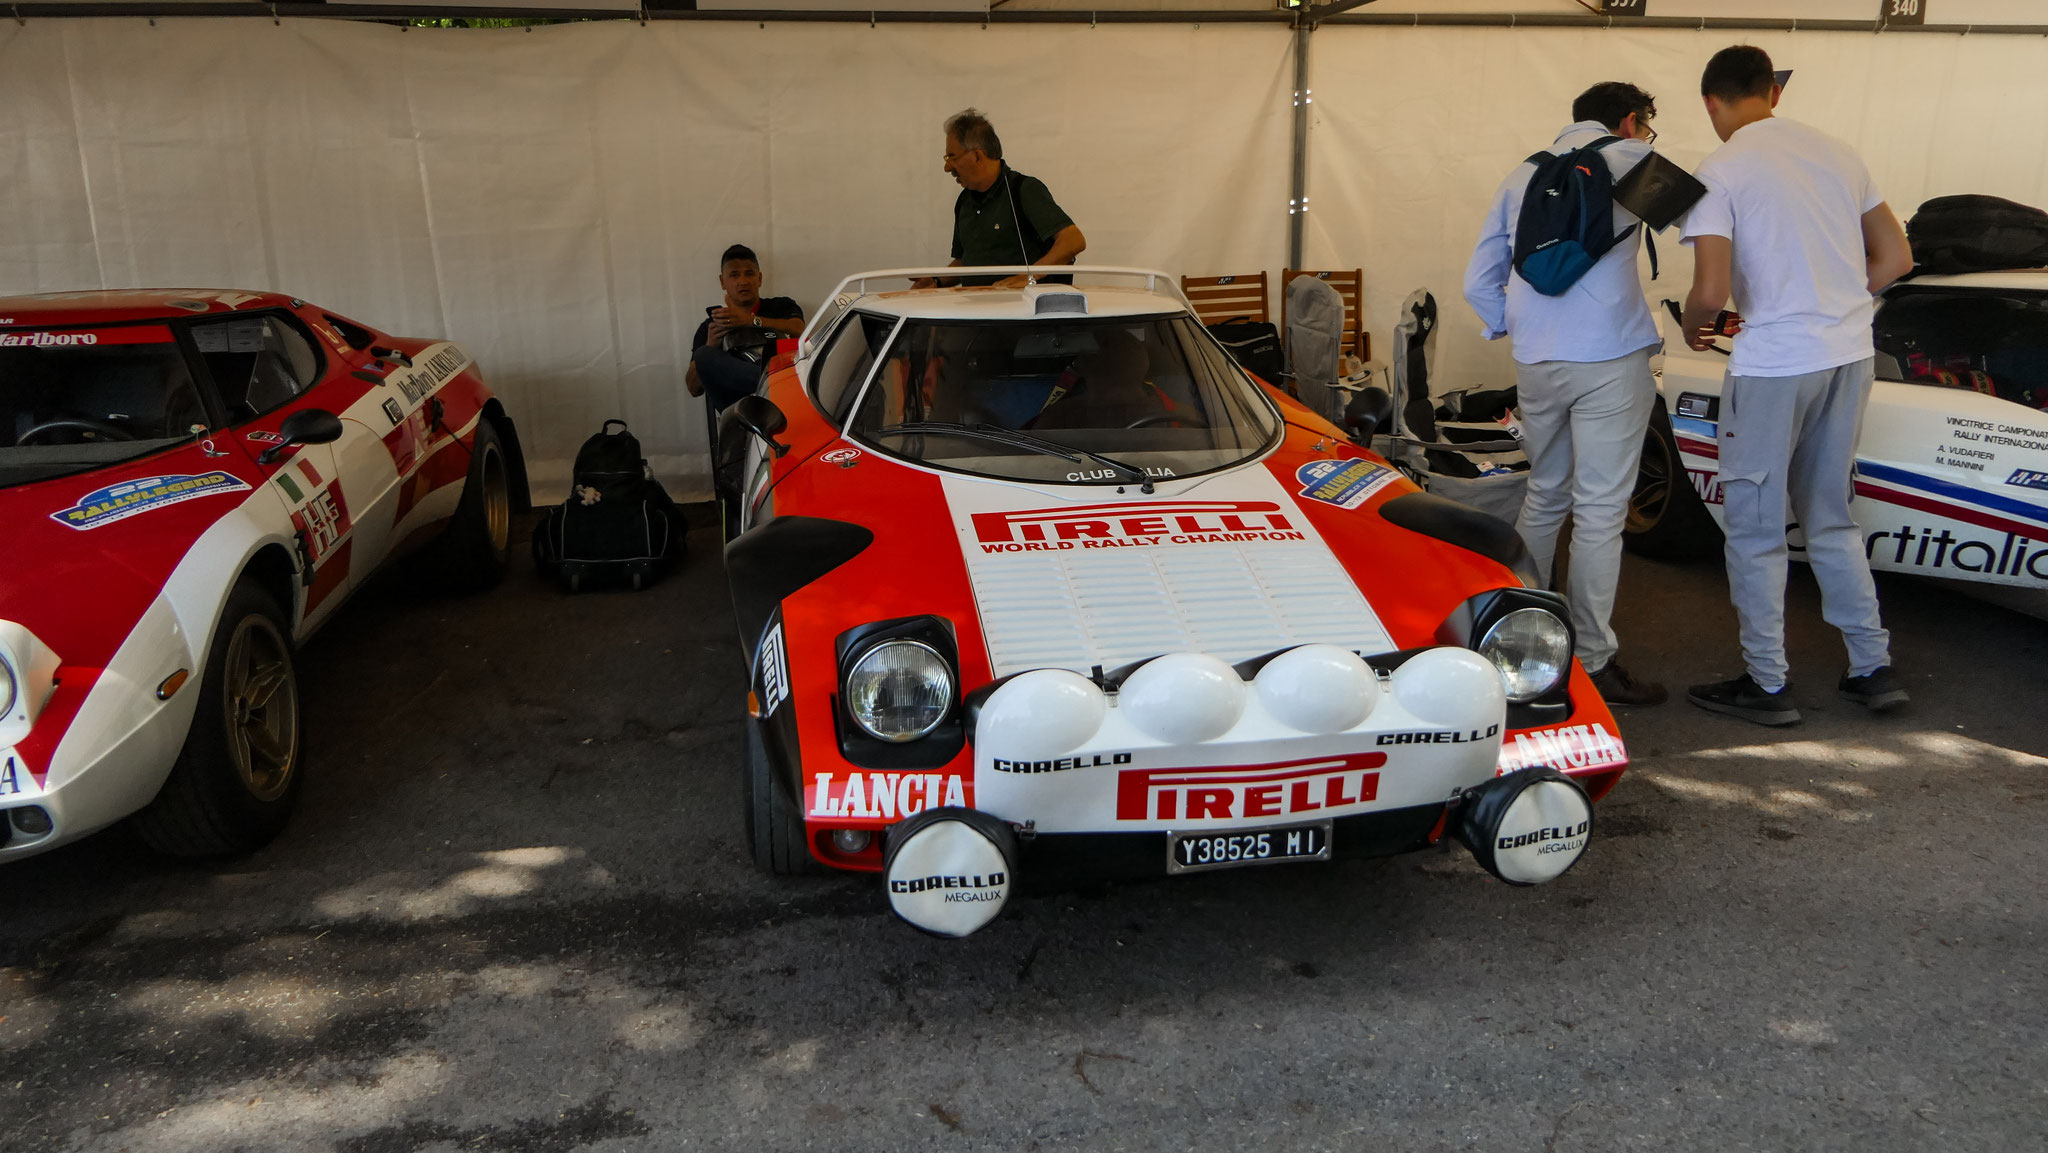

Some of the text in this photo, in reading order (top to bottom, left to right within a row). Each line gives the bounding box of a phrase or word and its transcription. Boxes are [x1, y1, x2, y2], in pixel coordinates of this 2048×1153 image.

[1946, 416, 1994, 431] VINCITRICE
[1953, 429, 1981, 442] RALLY
[1949, 446, 1995, 461] VUDAFIERI
[1066, 469, 1117, 482] CLUB
[1947, 458, 1985, 472] MANNINI
[970, 500, 1294, 543] PIRELLI
[981, 530, 1306, 554] WORLD RALLY CHAMPION
[761, 622, 789, 717] PIRELLI
[1376, 723, 1499, 746] CARELLO
[993, 752, 1132, 773] CARELLO
[810, 772, 966, 819] LANCIA
[1116, 751, 1388, 821] PIRELLI
[1497, 820, 1588, 850] CARELLO
[1183, 833, 1271, 864] Y38525
[1536, 838, 1584, 857] MEGALUX
[891, 871, 1005, 893] CARELLO
[944, 889, 1002, 903] MEGALUX
